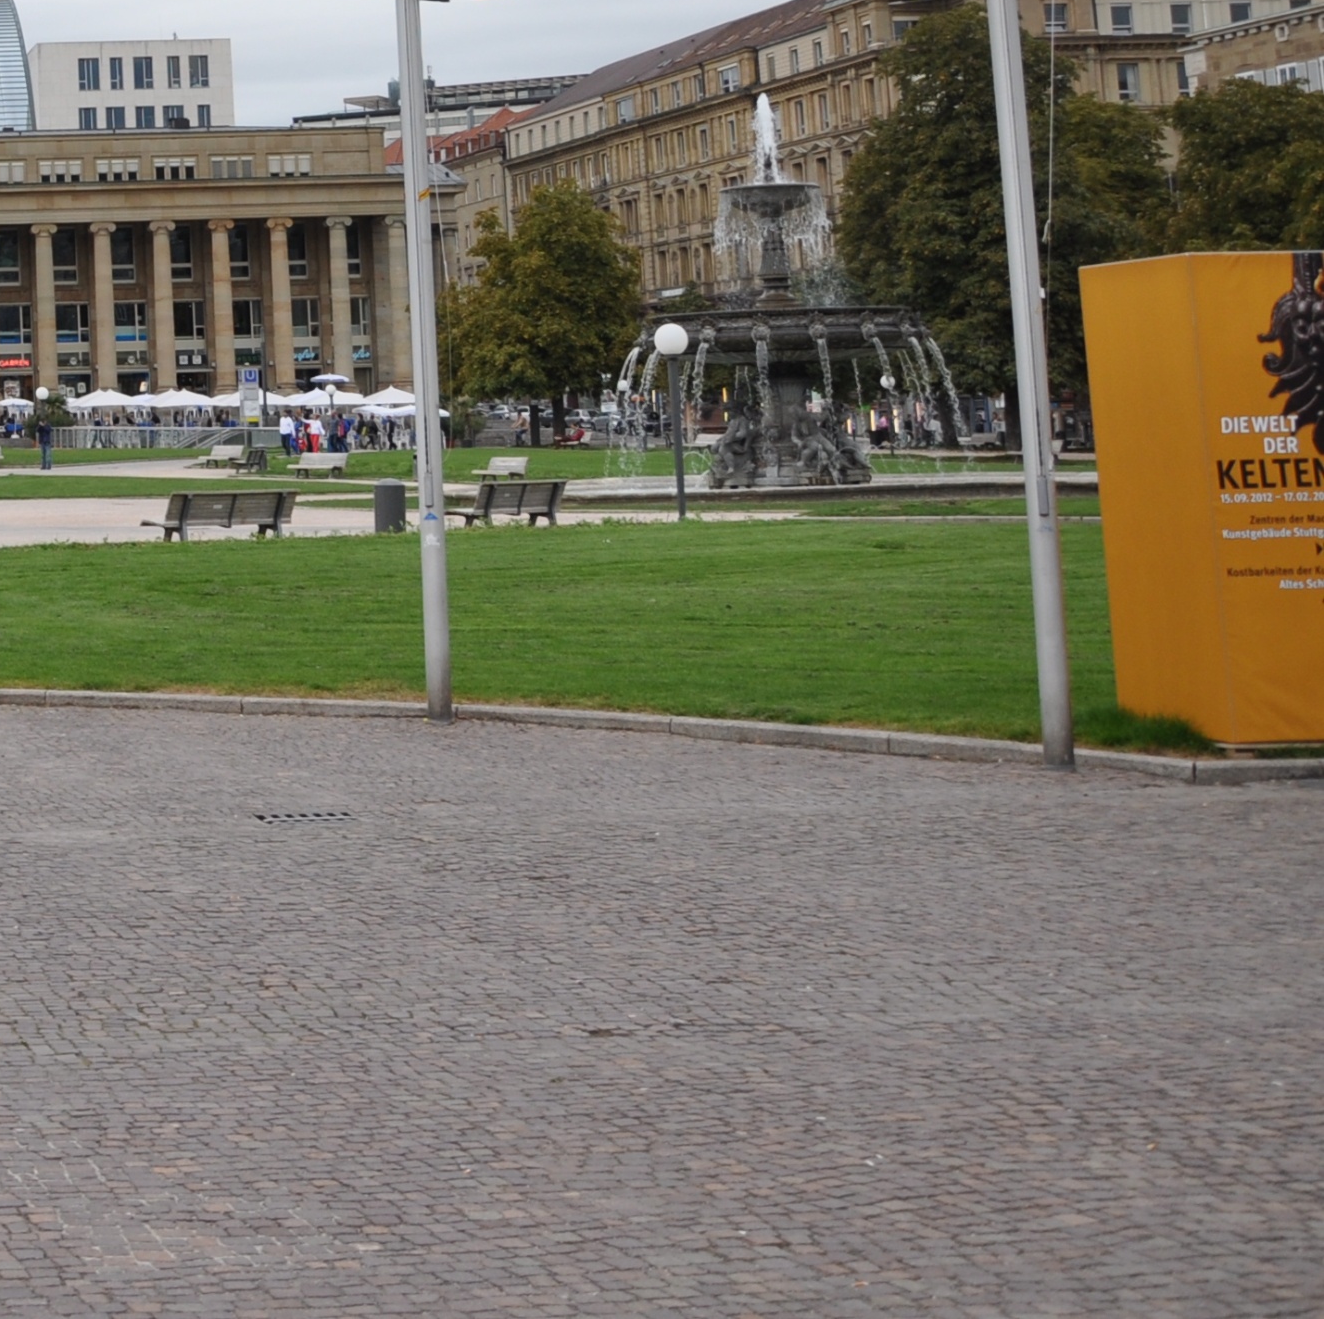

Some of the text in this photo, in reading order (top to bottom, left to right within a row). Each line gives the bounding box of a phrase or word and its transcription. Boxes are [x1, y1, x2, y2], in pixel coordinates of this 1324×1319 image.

[1220, 415, 1299, 434] DIE WELT
[1263, 436, 1299, 454] DER
[1249, 515, 1286, 525] Zentren
[1289, 515, 1304, 524] der
[1221, 527, 1292, 540] Kunstgebäude
[1226, 567, 1294, 577] Kostbarkeiten
[1297, 566, 1312, 575] der
[1279, 579, 1304, 589] Altes
